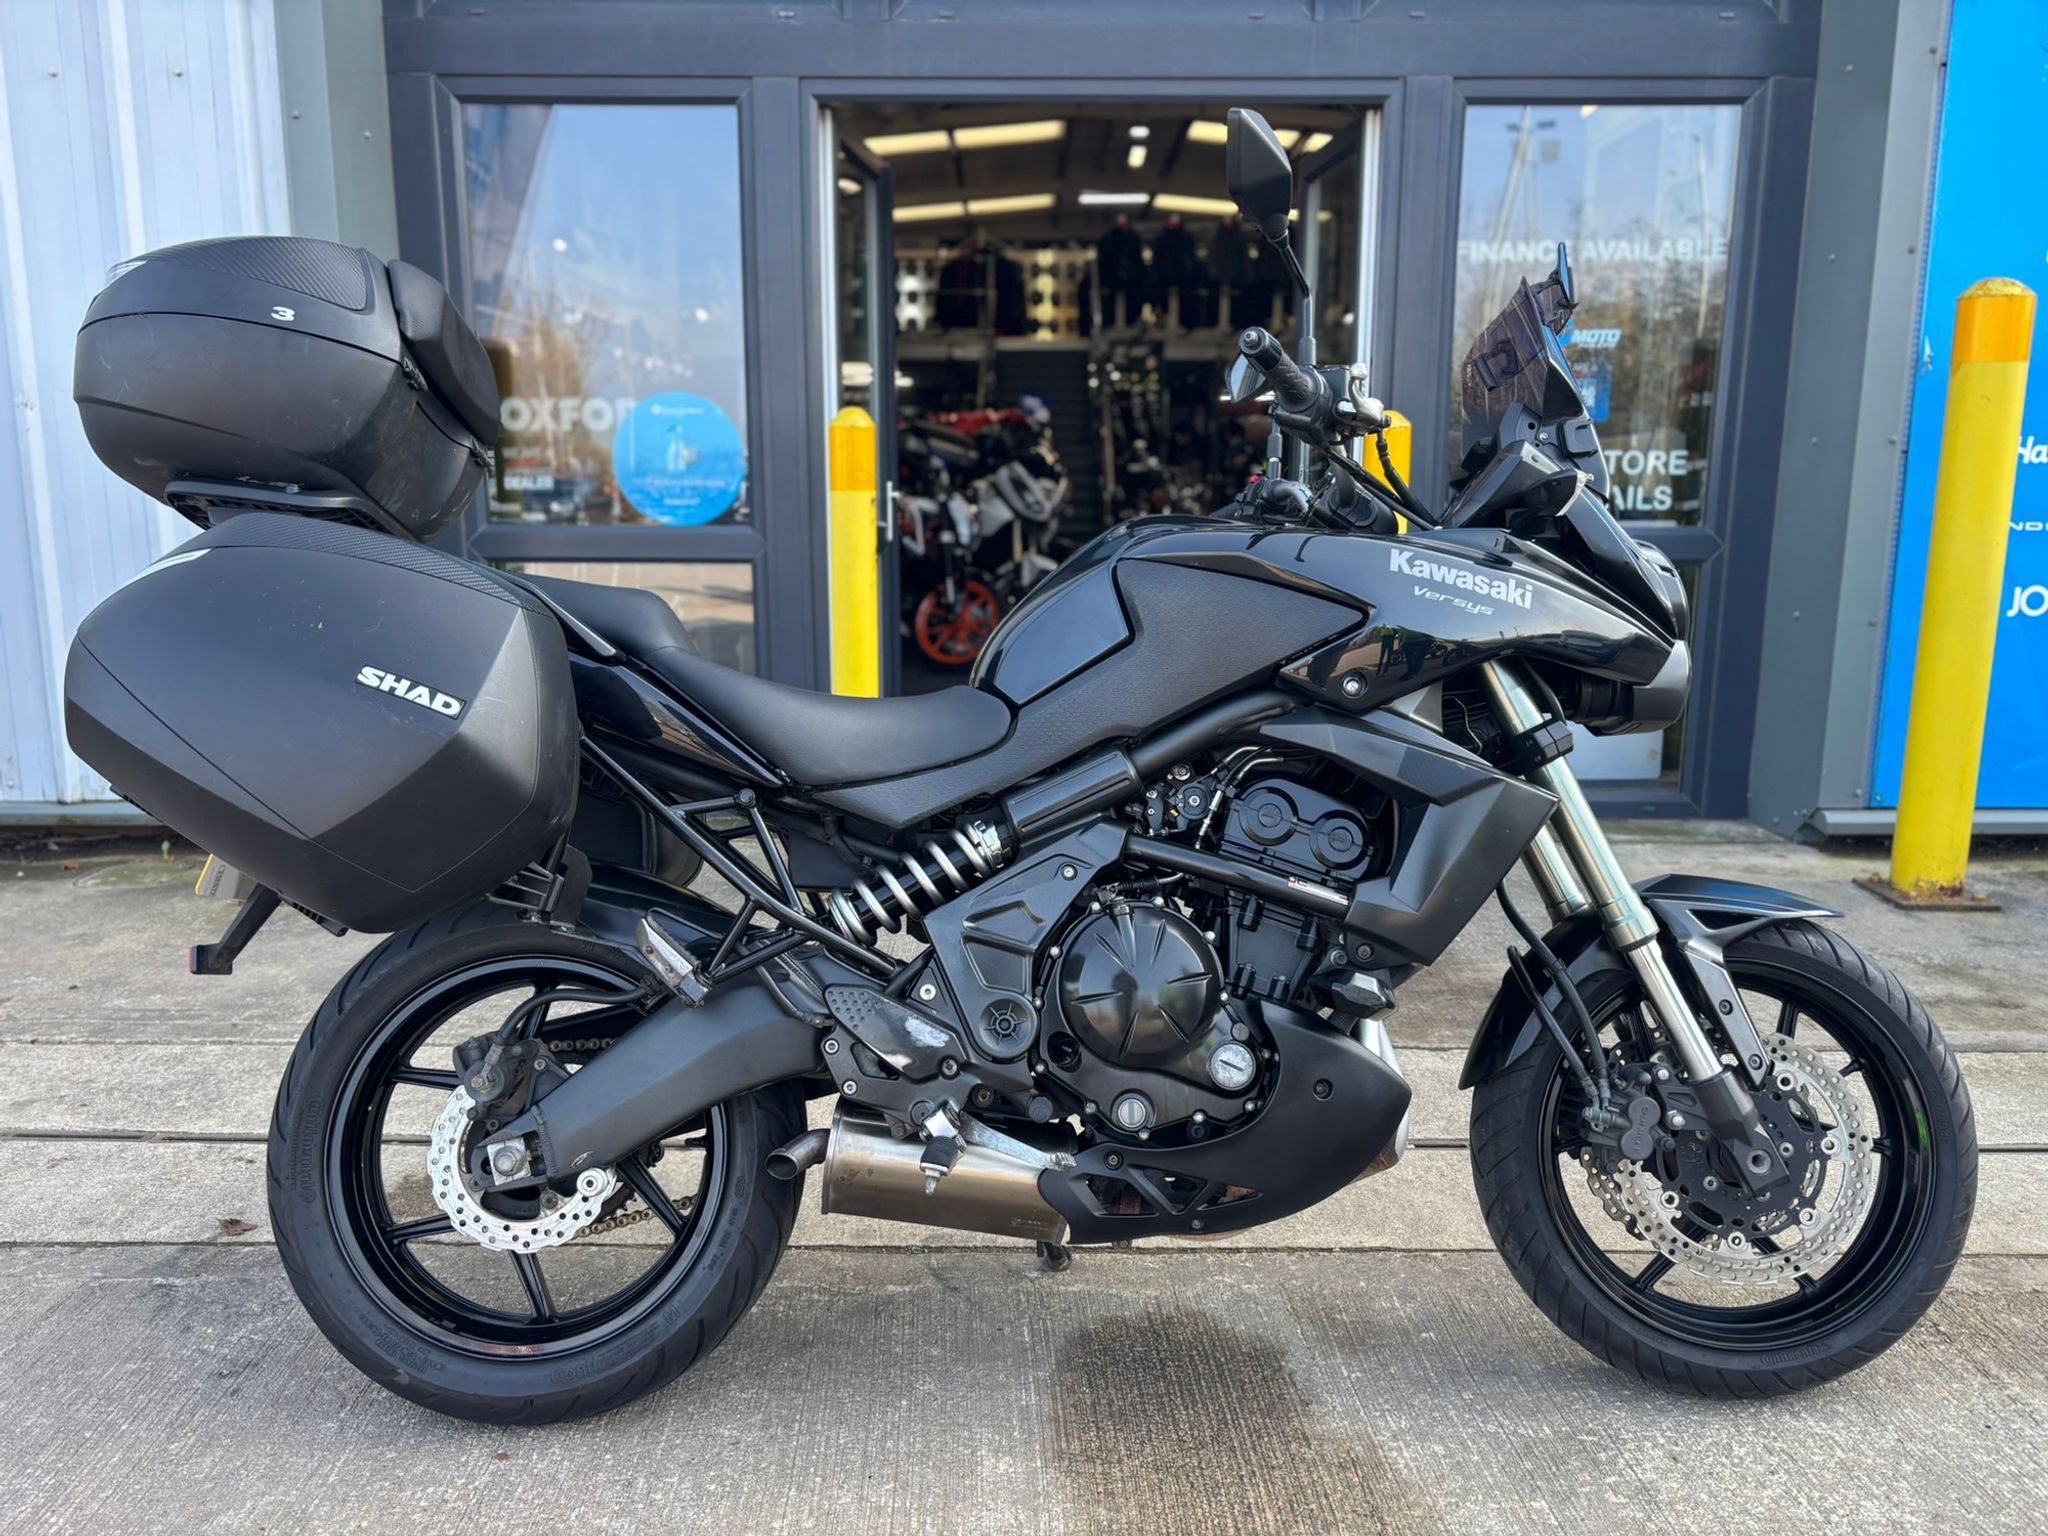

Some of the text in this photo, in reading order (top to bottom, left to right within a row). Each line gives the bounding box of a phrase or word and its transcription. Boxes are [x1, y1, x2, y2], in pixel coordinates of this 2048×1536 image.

[1579, 239, 1727, 262] AVAILABLE
[500, 396, 638, 432] OXFO
[1604, 449, 1688, 476] TORE
[1607, 485, 1673, 511] AILS
[1390, 548, 1533, 609] Kawasaki
[356, 666, 461, 716] SHAD
